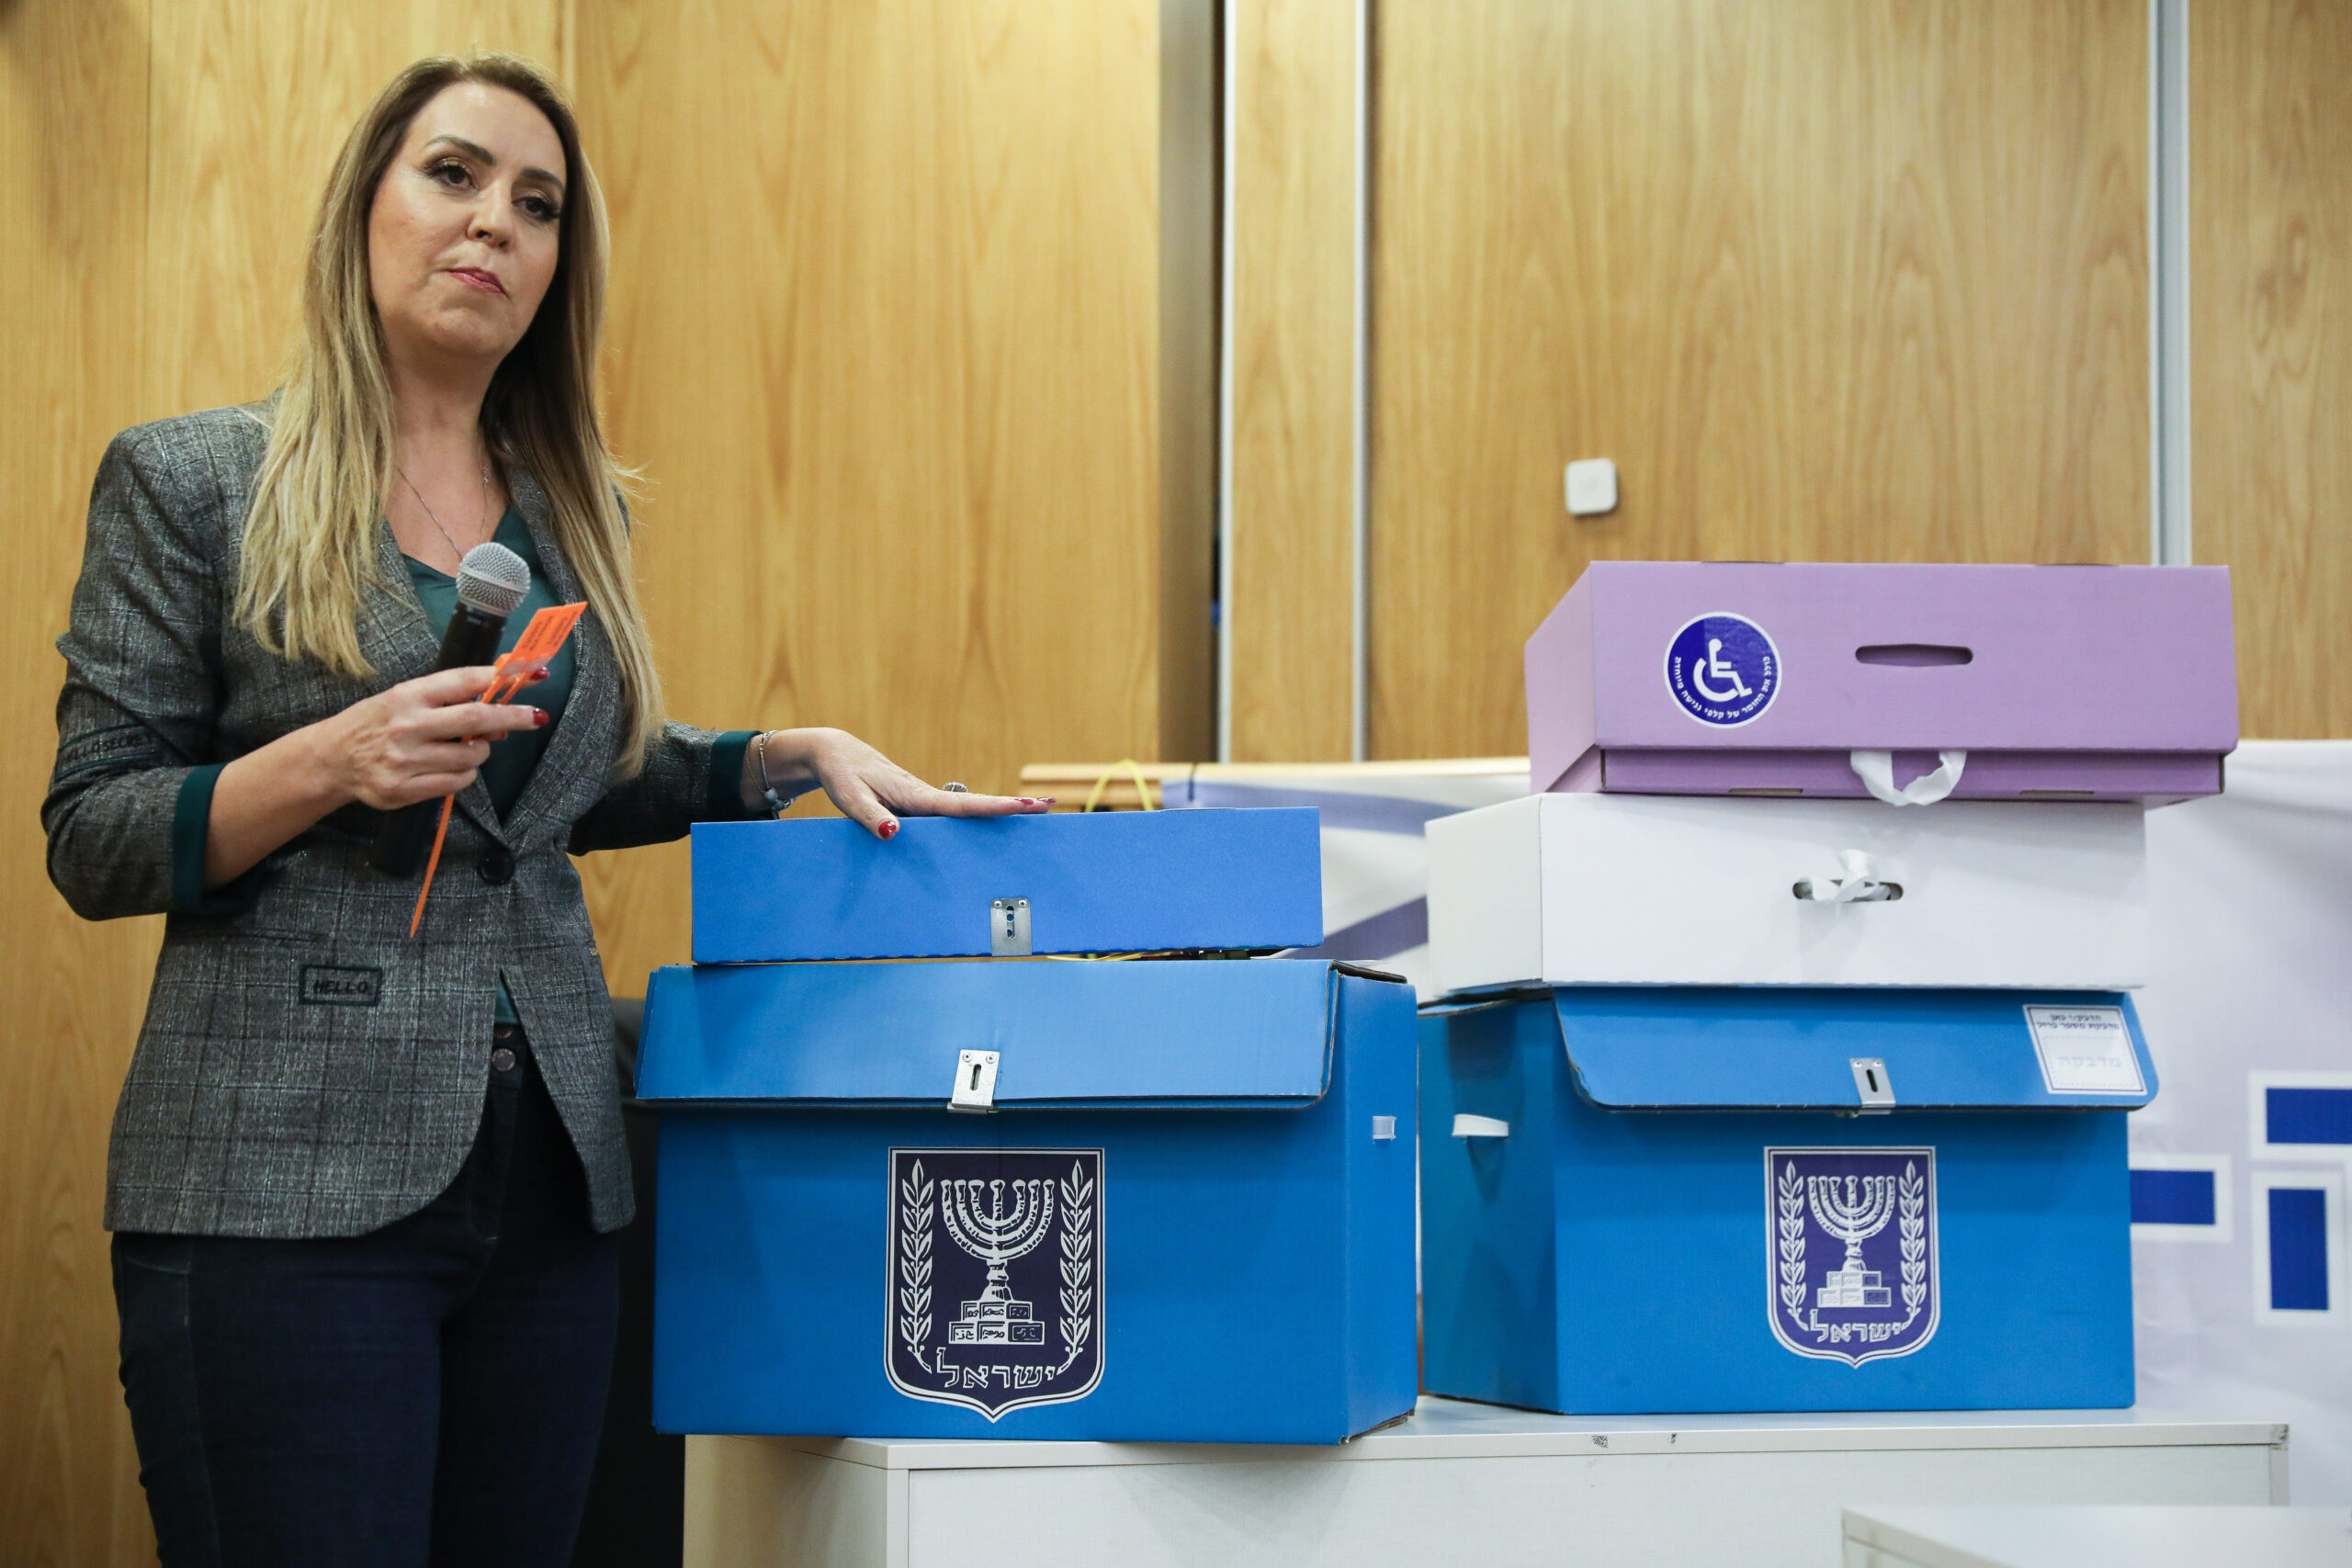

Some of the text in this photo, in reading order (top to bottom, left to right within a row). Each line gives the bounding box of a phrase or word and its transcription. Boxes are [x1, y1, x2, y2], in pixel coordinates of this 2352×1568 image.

[1674, 656, 1685, 689] מיוחדת
[1761, 678, 1771, 693] את
[1681, 690, 1702, 711] נגישה
[1742, 693, 1765, 713] החומר
[1704, 708, 1724, 719] קלפי
[1727, 710, 1740, 718] של
[313, 980, 368, 995] HELLO
[2058, 1056, 2122, 1069] מדבקה
[1809, 1308, 1902, 1343] ישראל
[936, 1347, 1056, 1388] ישראל
